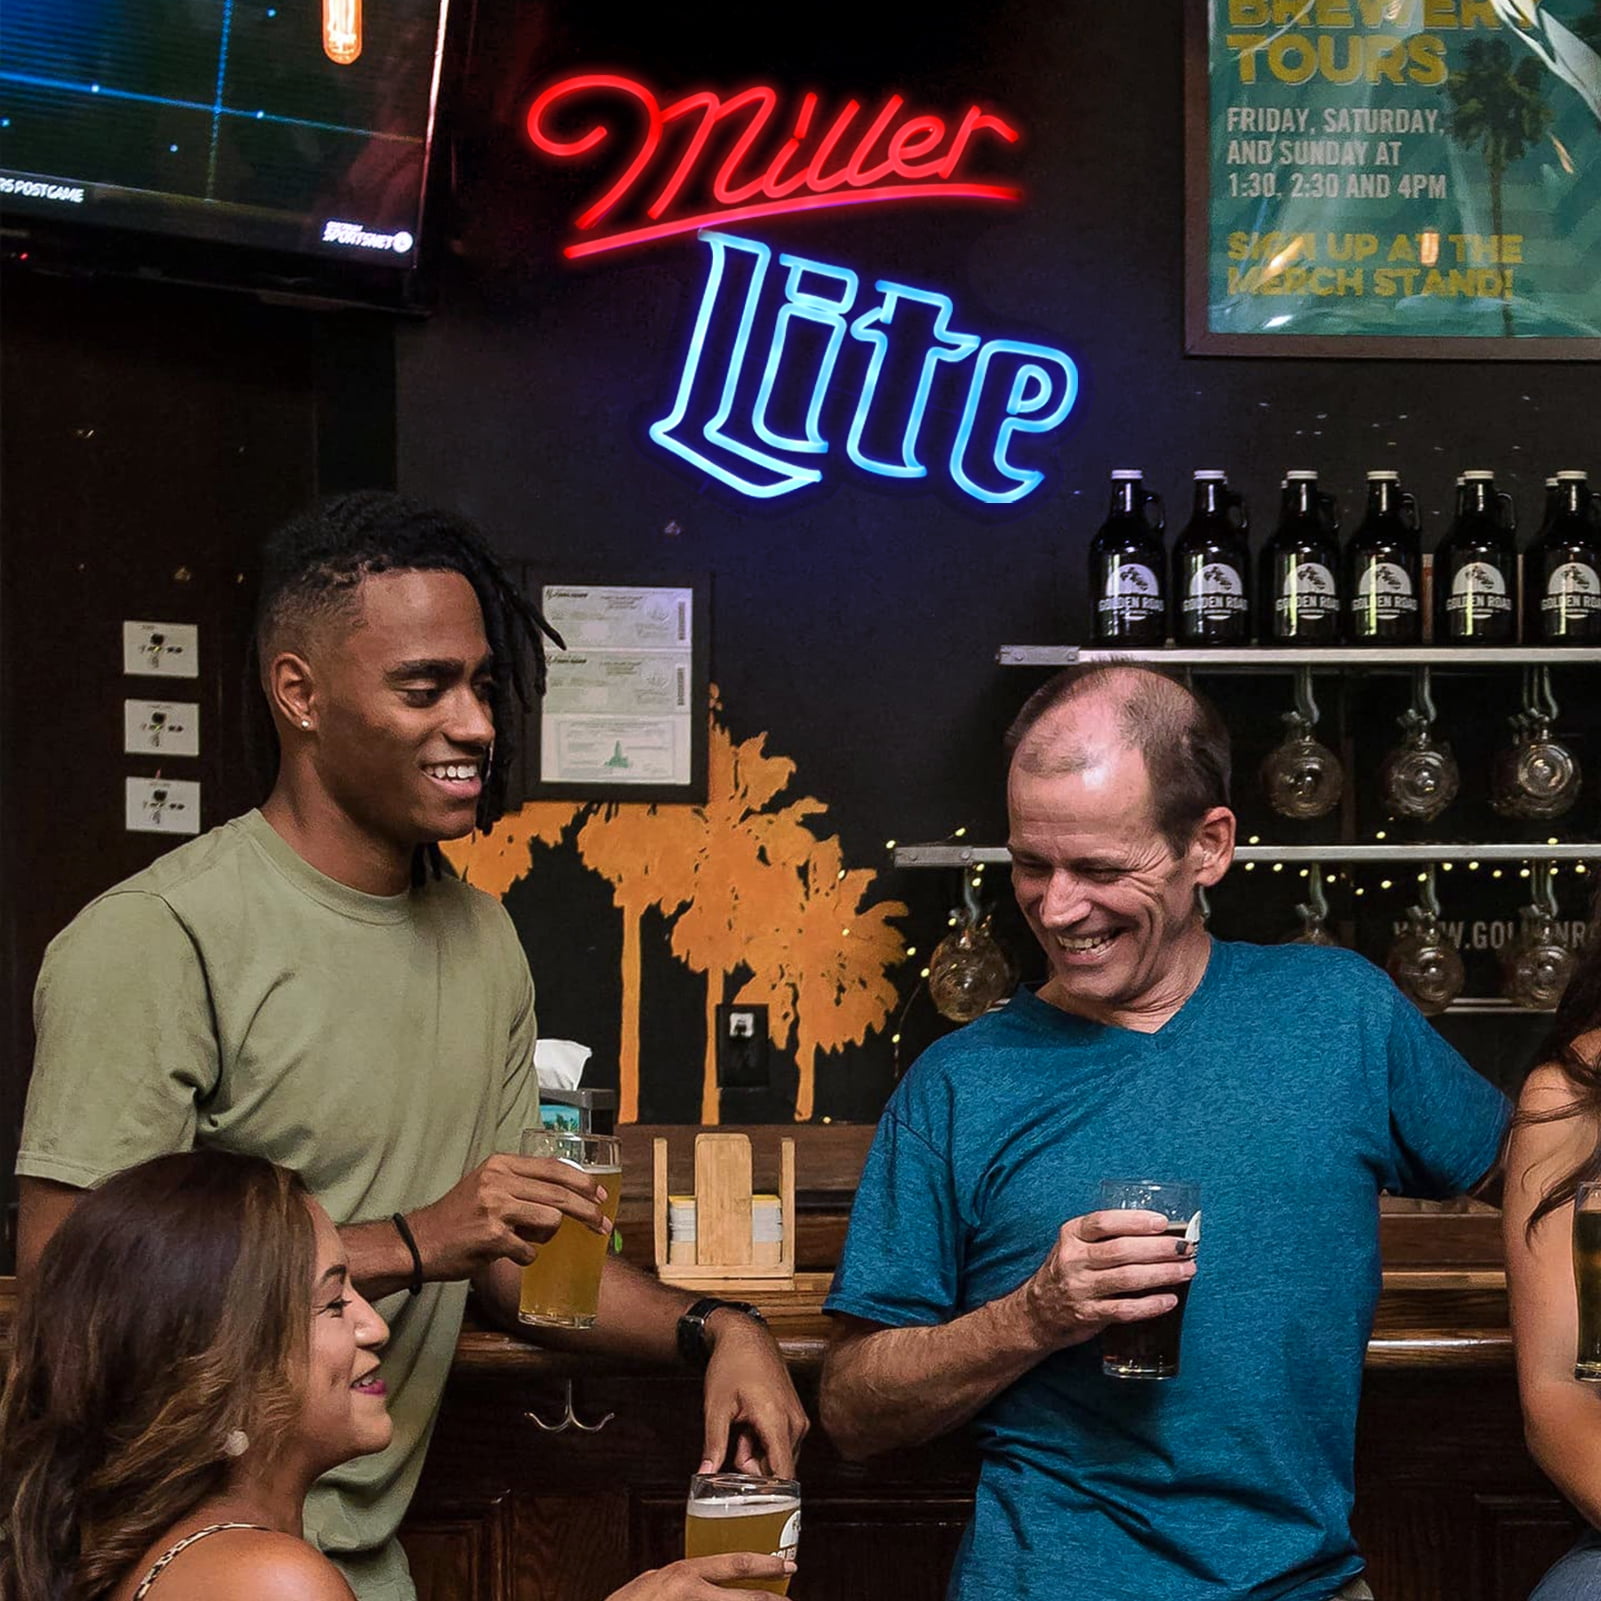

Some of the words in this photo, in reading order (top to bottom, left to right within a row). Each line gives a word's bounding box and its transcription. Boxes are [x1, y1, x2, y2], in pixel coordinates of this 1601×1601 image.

[1228, 0, 1533, 29] BREWER
[1226, 34, 1448, 86] TOURS
[1226, 107, 1316, 135] FRIDAY,
[1323, 107, 1445, 135] SATURDAY,
[526, 73, 1019, 230] Miller
[1227, 140, 1272, 165] AND
[1279, 140, 1368, 166] SUNDAY
[1375, 141, 1402, 166] AT
[14, 180, 84, 203] POSTGAME
[1229, 172, 1282, 199] 1:30,
[1291, 173, 1338, 198] 2:30
[1345, 174, 1390, 198] AND
[1398, 174, 1447, 199] 4PM
[1326, 233, 1379, 261] UP
[1448, 234, 1524, 264] THE
[1373, 267, 1514, 299] STAND!
[649, 227, 1079, 503] Lite
